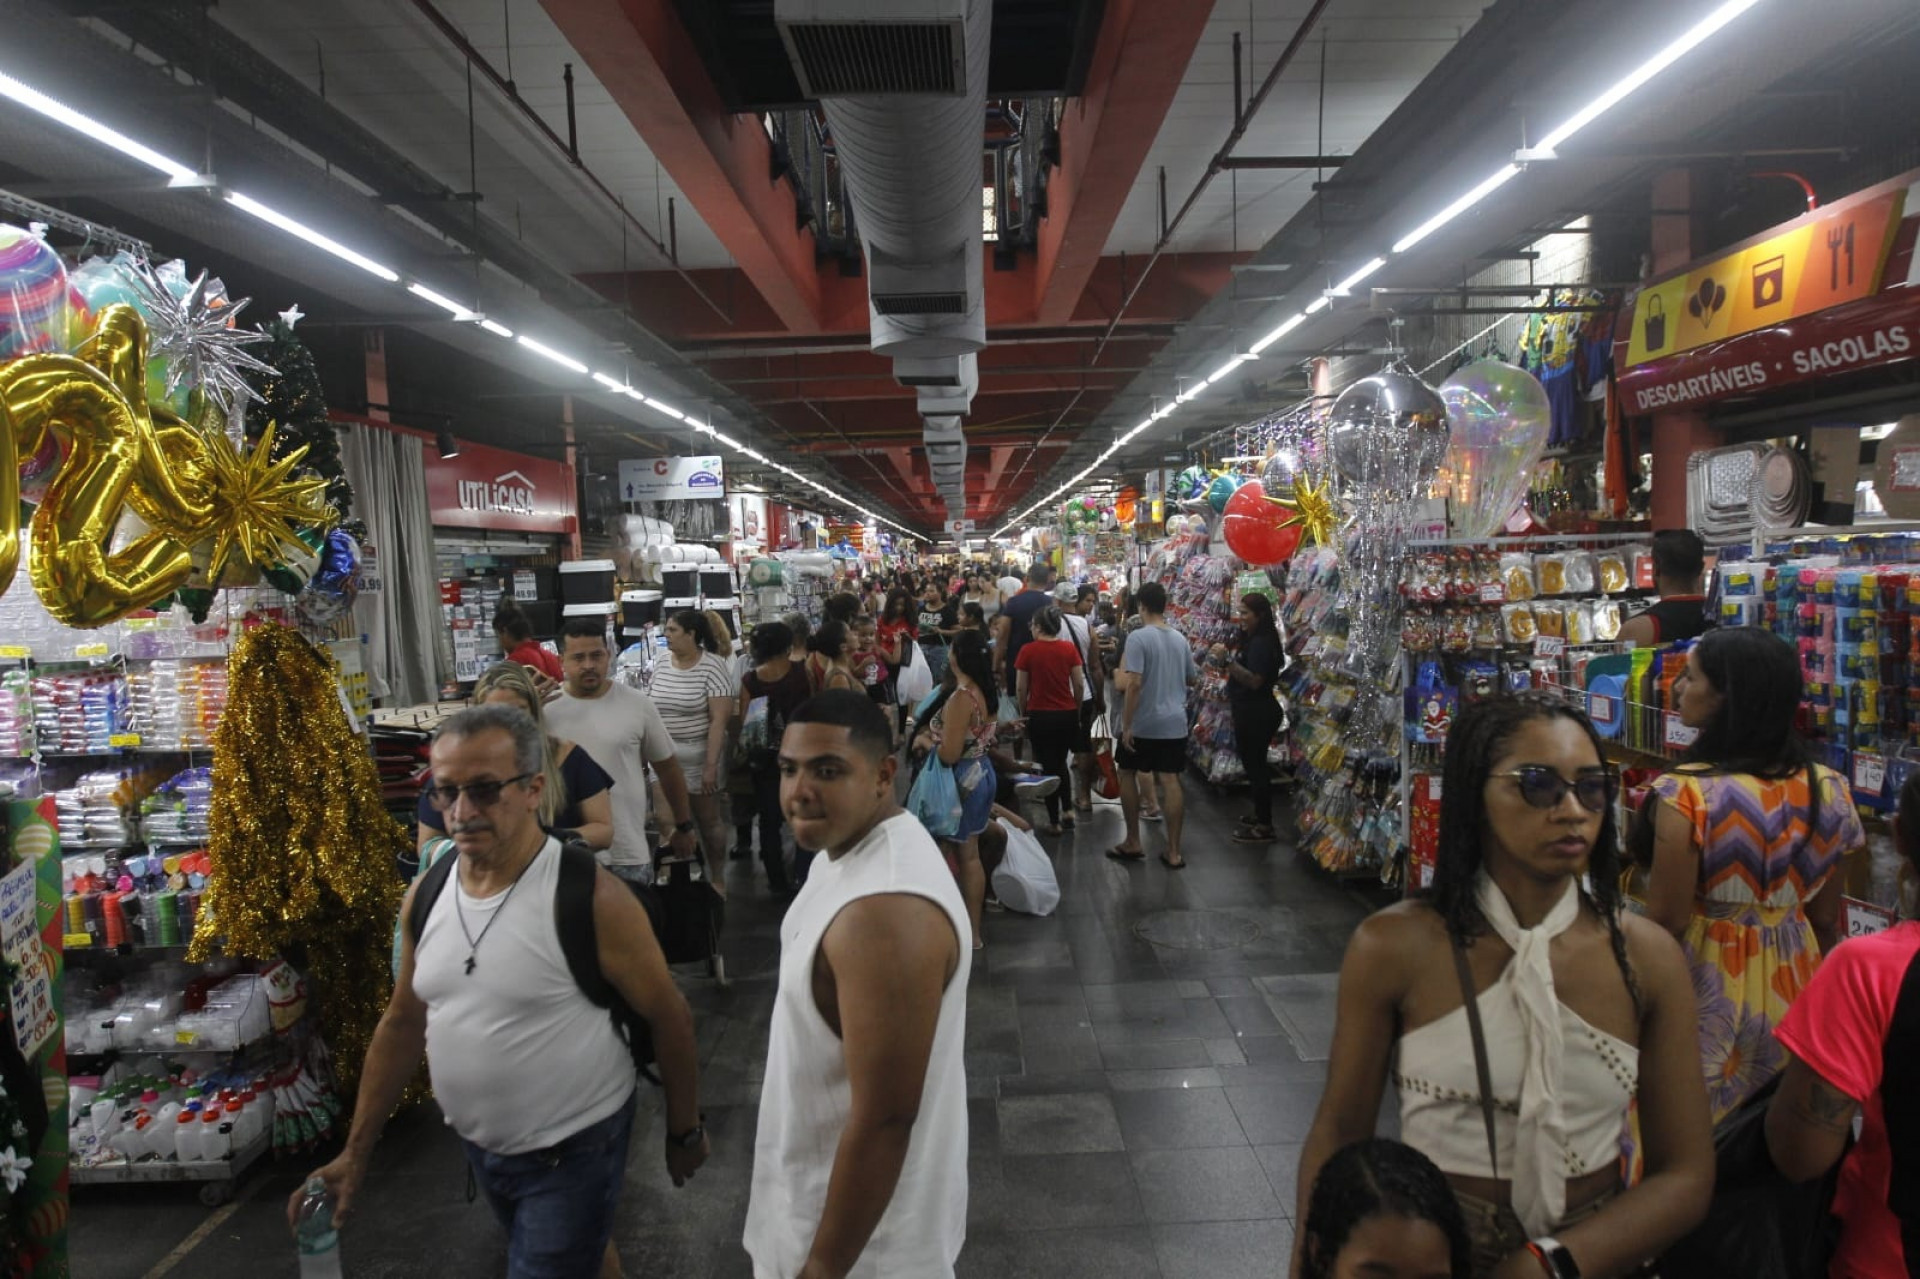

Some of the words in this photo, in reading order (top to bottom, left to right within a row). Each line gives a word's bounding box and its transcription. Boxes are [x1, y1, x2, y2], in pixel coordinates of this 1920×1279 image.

[1636, 361, 1767, 410] DESCARTÁVEIS
[1792, 325, 1911, 374] SACOLAS
[654, 461, 668, 475] C
